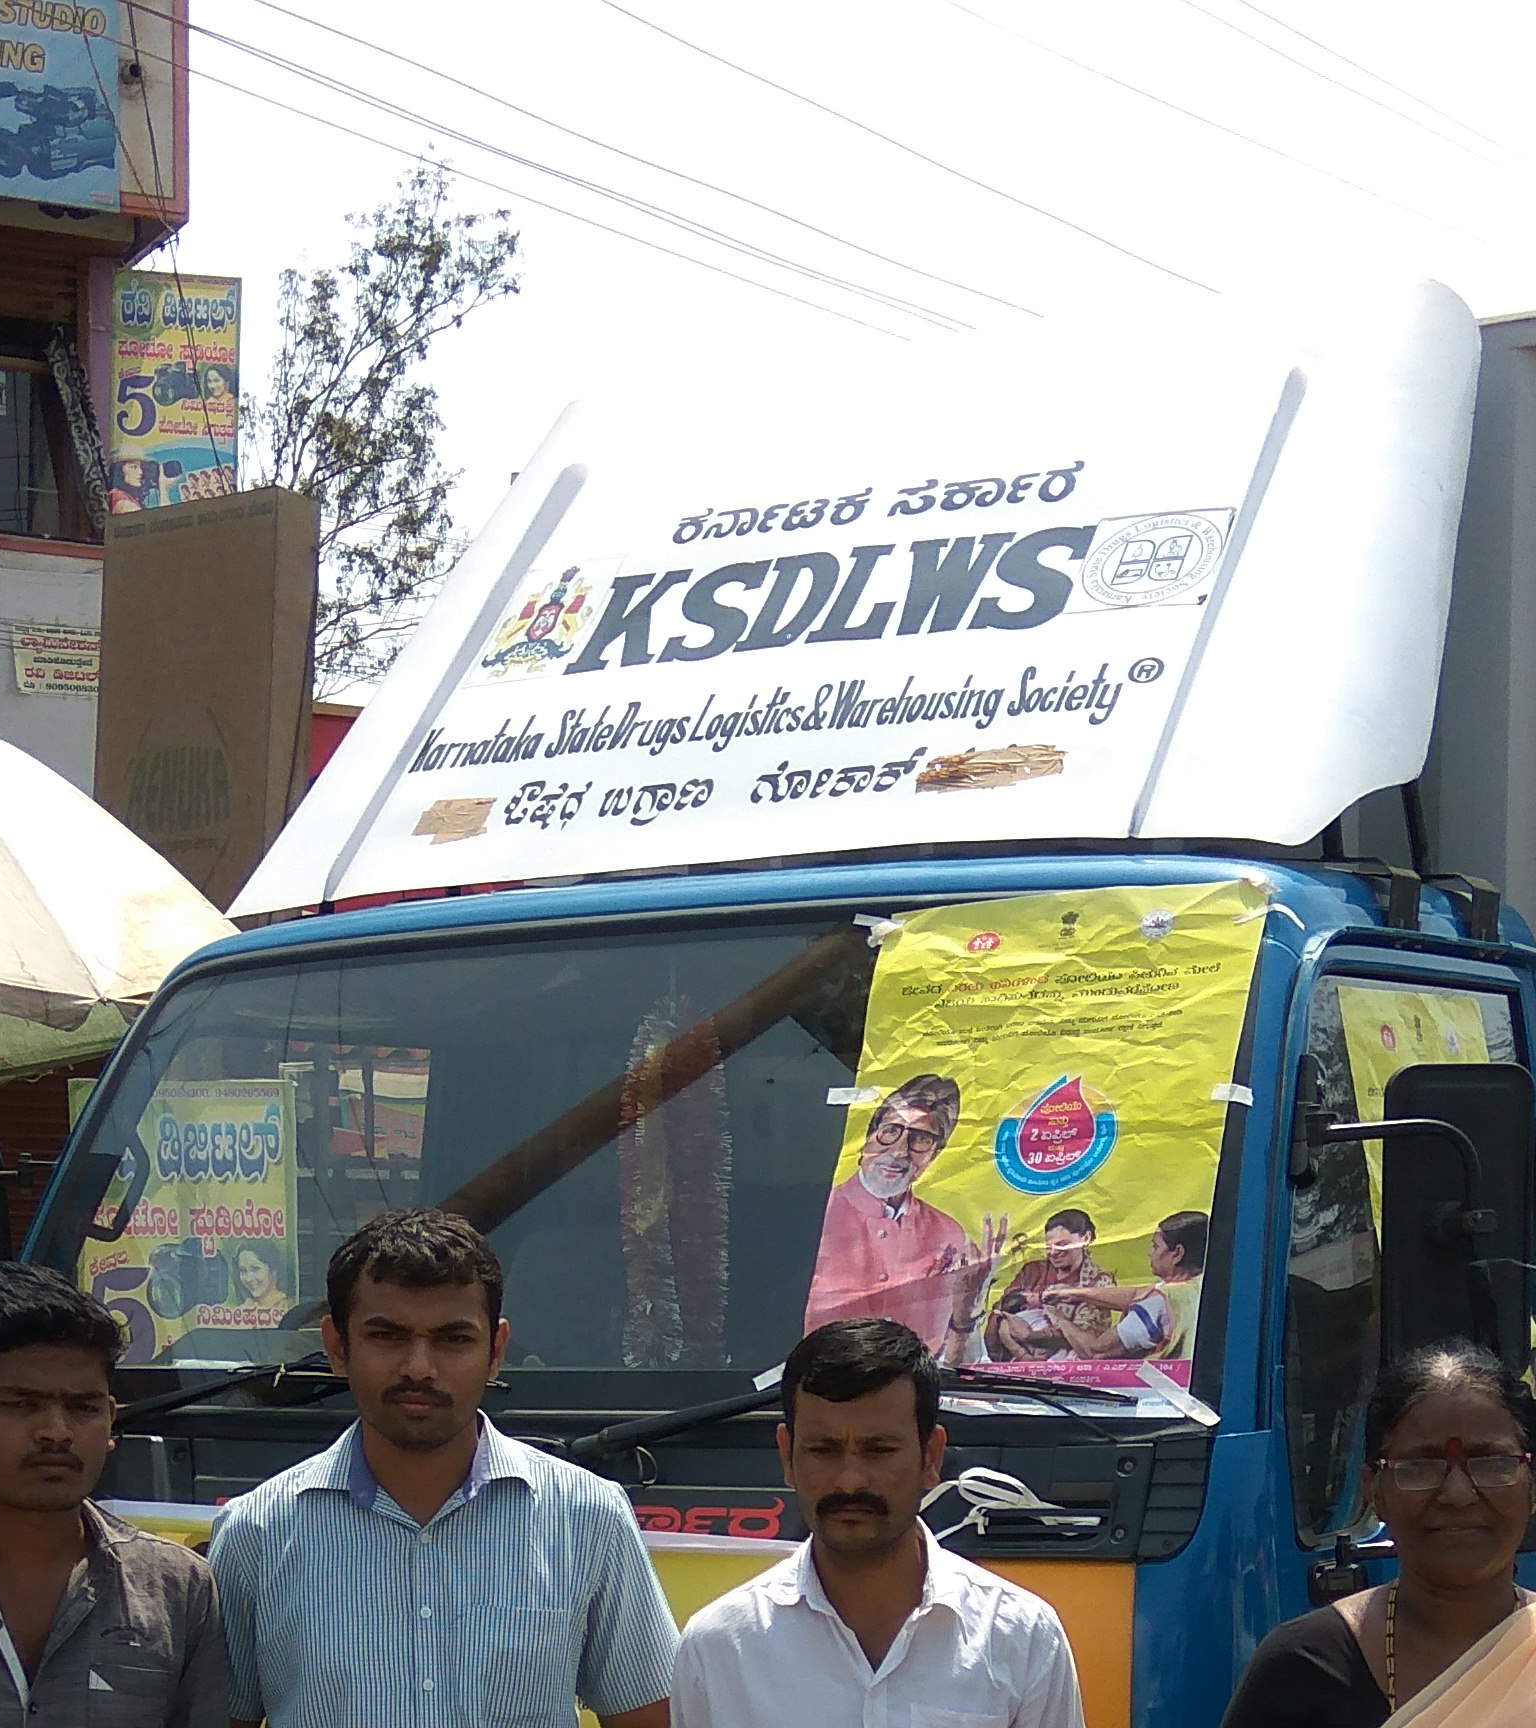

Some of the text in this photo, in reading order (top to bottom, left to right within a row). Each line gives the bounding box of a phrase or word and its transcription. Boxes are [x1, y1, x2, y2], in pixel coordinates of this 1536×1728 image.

[116, 374, 157, 437] 5
[671, 460, 1086, 544] ಕರ್ನಾಟಕ ಸರ್ಕಾರ
[562, 524, 1098, 677] KSDLWS
[408, 714, 546, 774] Karnataka
[749, 746, 928, 805] ಗೋಕಾಕ್
[157, 1102, 283, 1183] ಡಿಜಿಟಲ್
[1027, 1152, 1043, 1165] 30
[1031, 1128, 1039, 1141] 2
[189, 1199, 286, 1258] ಸ್ಟುಡಿಯೋ
